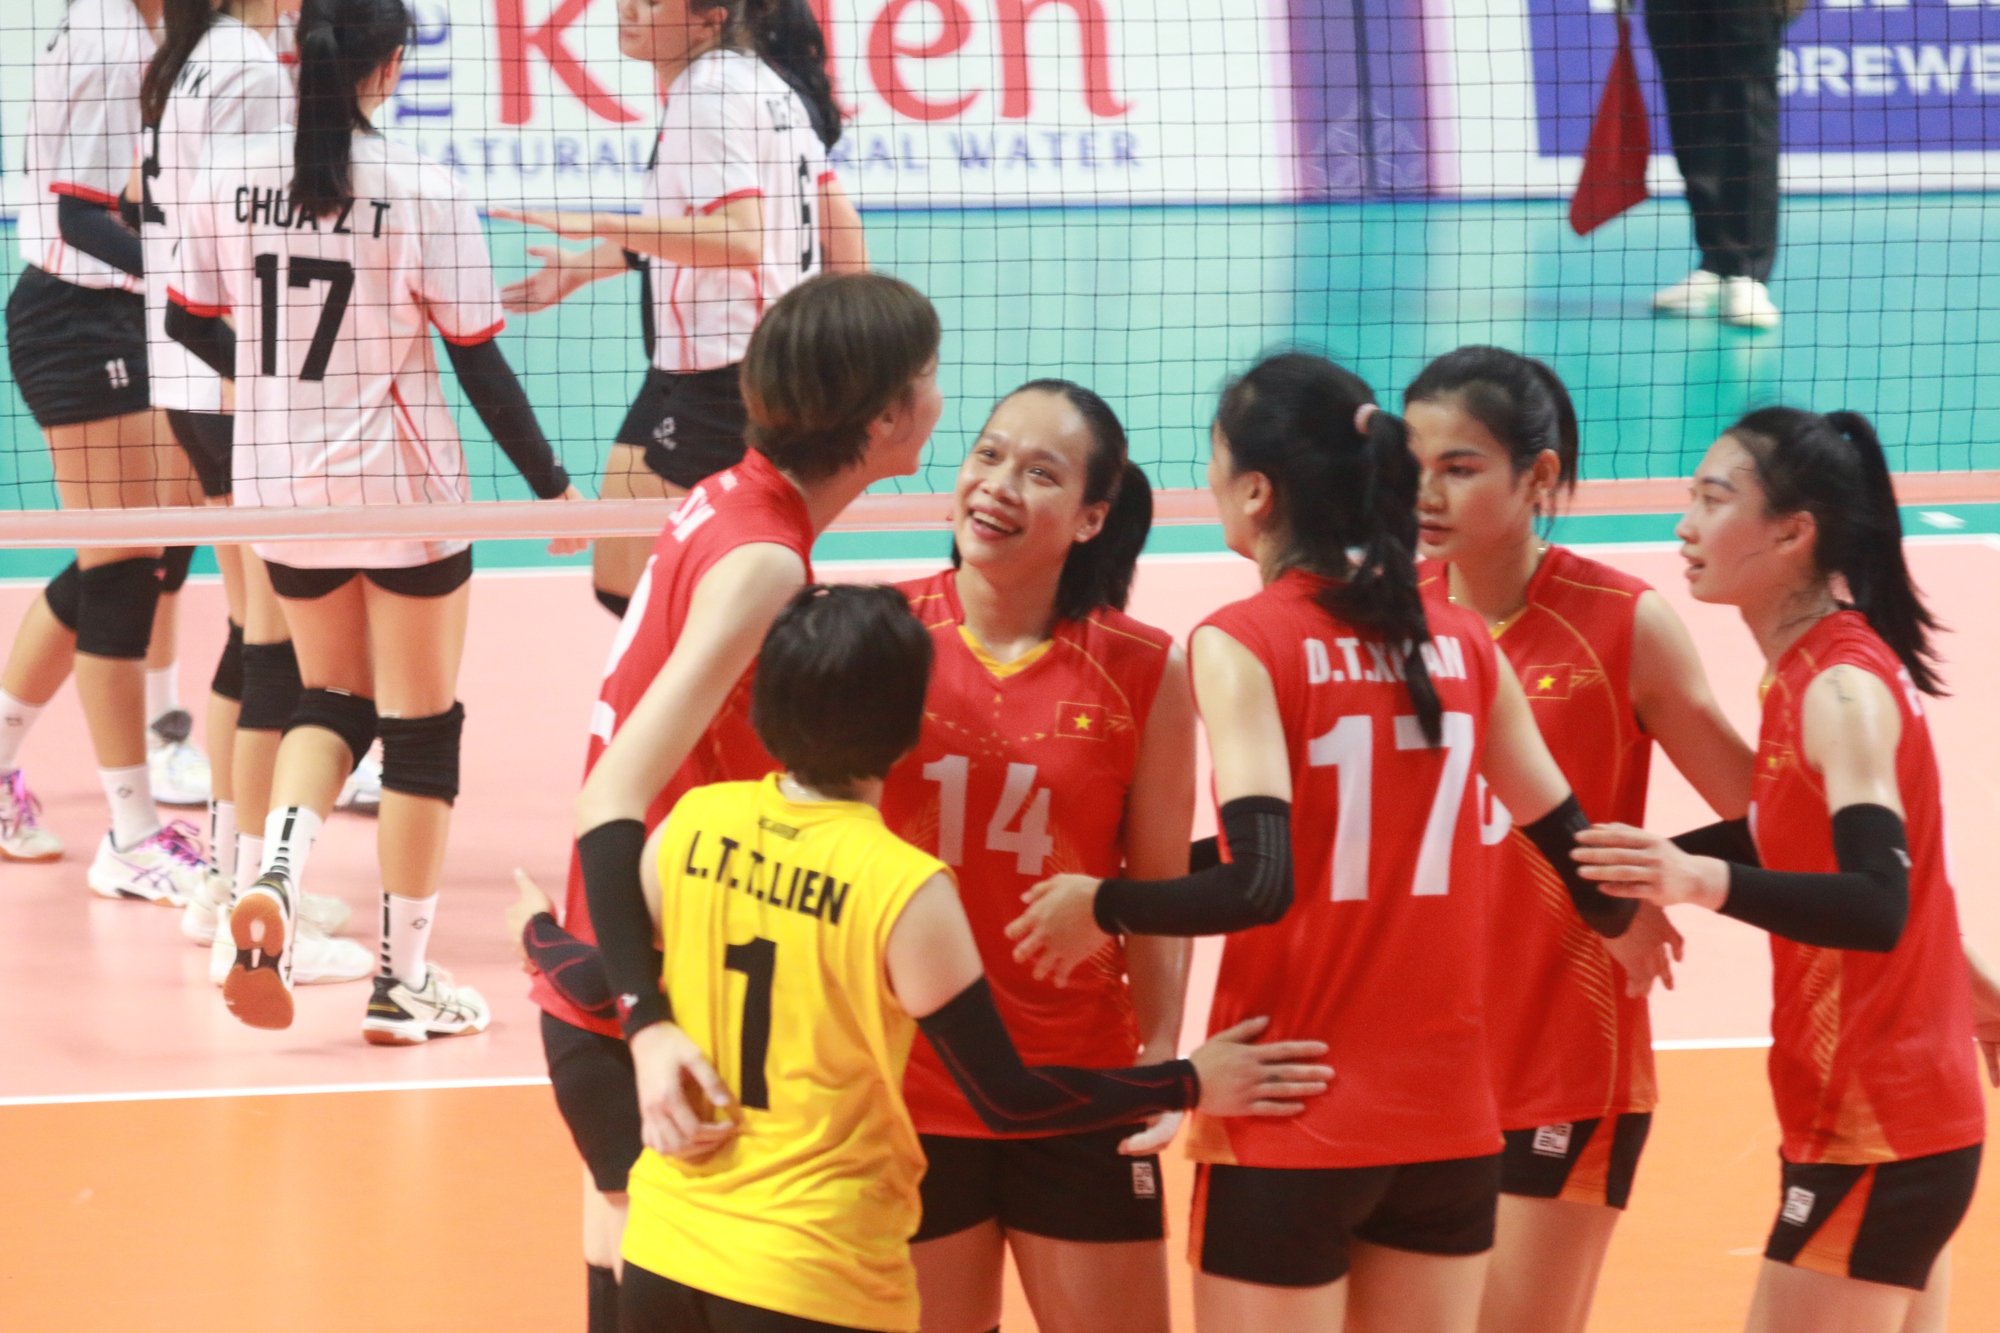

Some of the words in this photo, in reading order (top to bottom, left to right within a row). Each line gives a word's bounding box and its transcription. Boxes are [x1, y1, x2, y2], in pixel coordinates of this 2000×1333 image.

[494, 0, 1136, 125] Ken
[235, 186, 318, 232] CHUA
[370, 199, 391, 238] T
[949, 130, 1142, 170] WATER
[254, 252, 355, 381] 17
[922, 753, 1055, 877] 14
[1307, 711, 1475, 903] 17
[686, 829, 851, 927] L.T.T.LIEN
[724, 936, 777, 1112] 1
